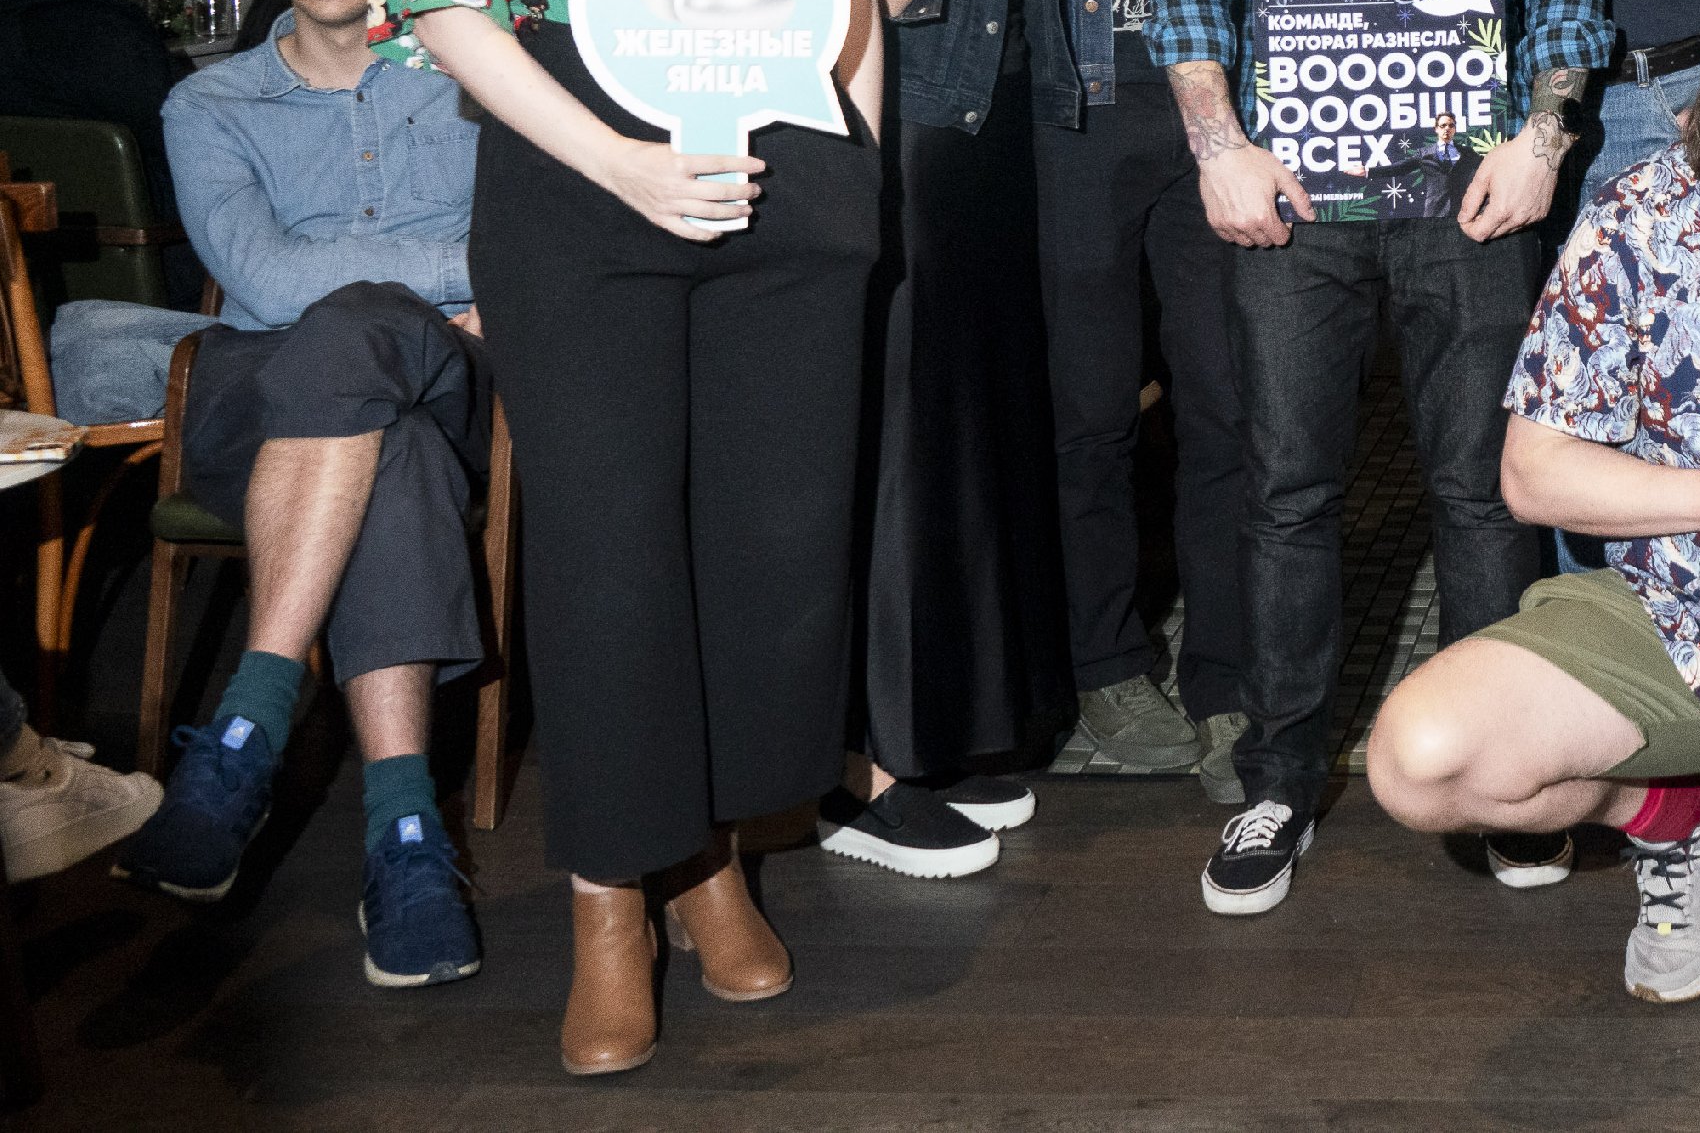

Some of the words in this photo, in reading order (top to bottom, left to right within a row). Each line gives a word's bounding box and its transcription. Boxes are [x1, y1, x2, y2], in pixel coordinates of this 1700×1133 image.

[612, 29, 814, 58] ЖЕЛЕЗНЫЕ
[1268, 33, 1360, 52] КОТОРАЯ
[1361, 30, 1462, 49] РАЗНЕСЛА
[667, 57, 769, 97] ЯЙЦА
[1271, 134, 1394, 172] ВСЕХ
